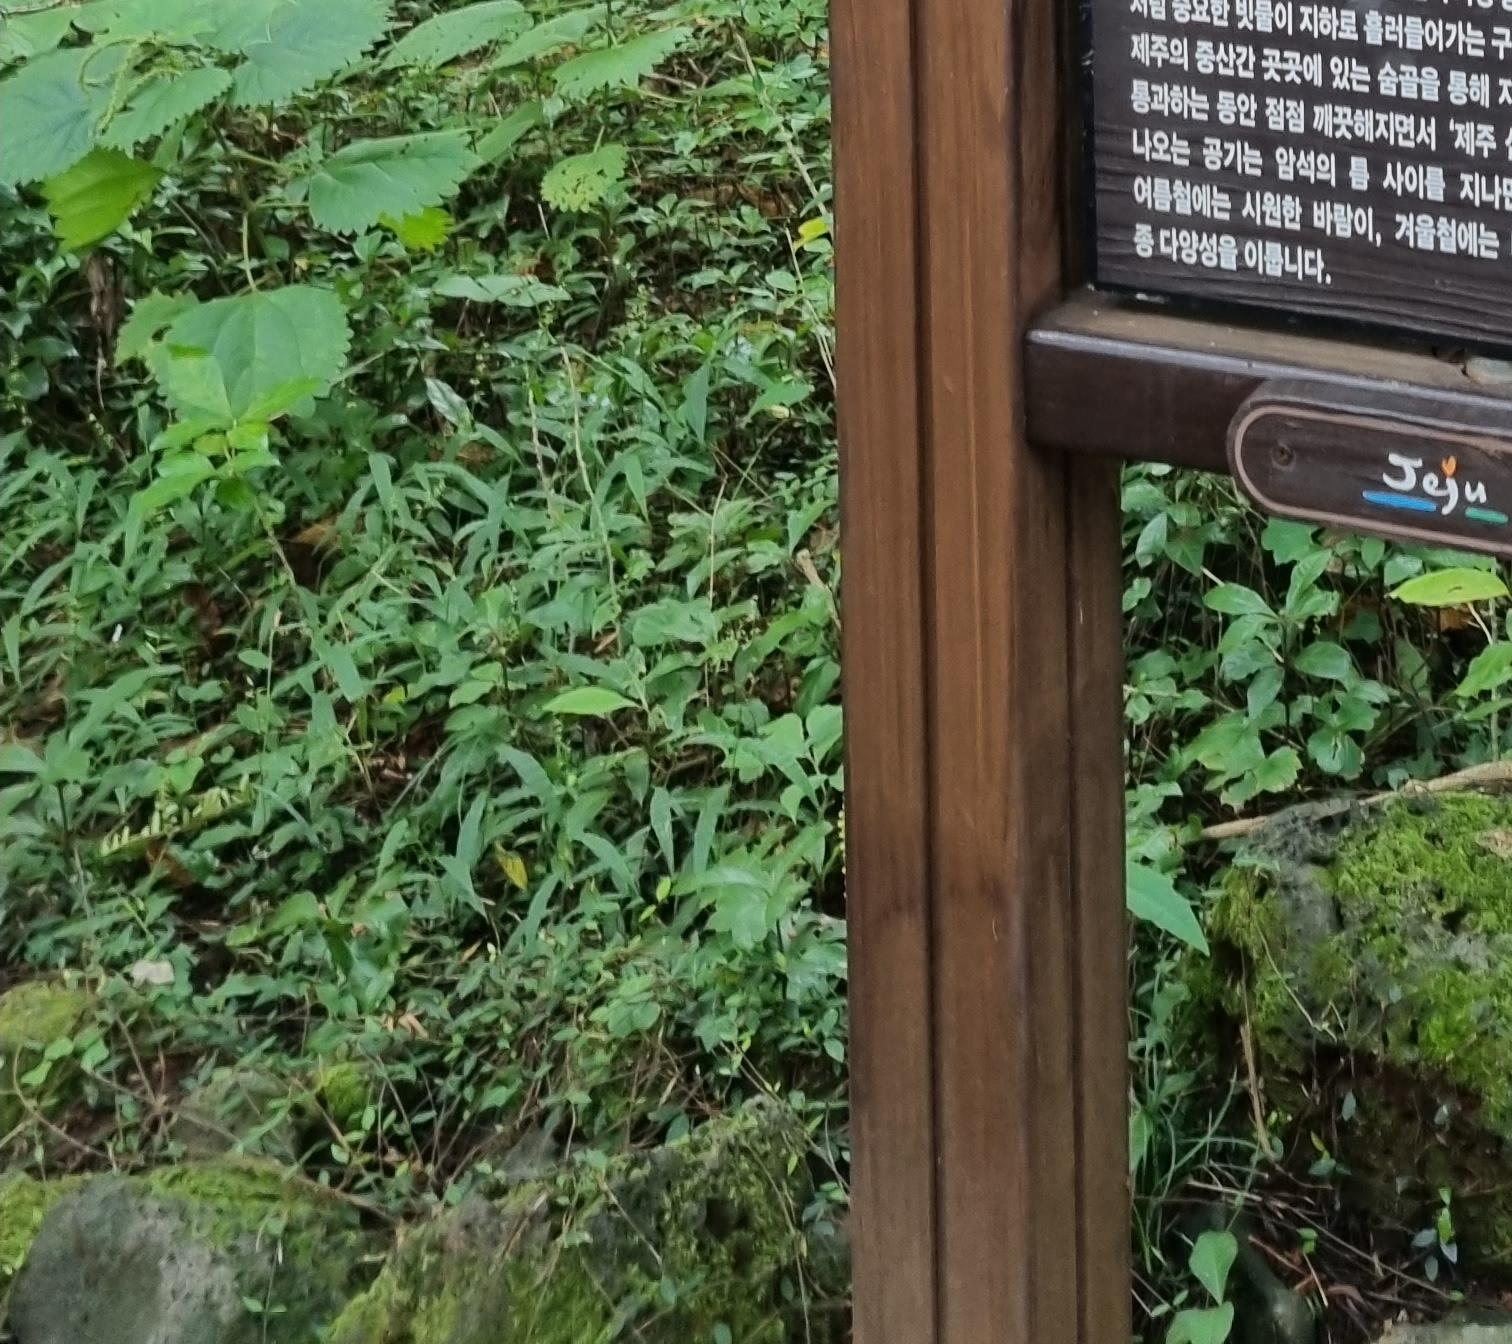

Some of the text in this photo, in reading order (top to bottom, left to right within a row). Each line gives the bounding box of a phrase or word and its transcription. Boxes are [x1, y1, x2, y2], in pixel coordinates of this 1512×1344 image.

[1299, 4, 1359, 41] 지하로
[1363, 9, 1486, 58] 흘러들어가는
[1130, 33, 1189, 72] 제주의
[1194, 40, 1256, 79] 중산간
[1261, 48, 1323, 88] 곳곳에
[1329, 56, 1371, 93] 있는
[1377, 61, 1441, 102] 숨골을
[1447, 70, 1490, 109] 통해
[1130, 79, 1210, 121] 통과하는
[1216, 90, 1258, 128] 동안
[1264, 97, 1305, 134] 점점
[1312, 103, 1436, 151] 깨끗해지면서
[1132, 127, 1191, 167] 나오는
[1202, 137, 1263, 177] 공기는
[1275, 146, 1336, 188] 암석의
[1348, 156, 1370, 191] 틈
[1382, 161, 1446, 202] 사이를
[1133, 175, 1232, 221] 여름철에는
[1241, 190, 1303, 231] 시원한
[1313, 200, 1382, 247] 바람이,
[1395, 212, 1500, 259] 겨울철에는
[1133, 223, 1332, 285] 종 다양성을 이룹니다.
[1381, 451, 1488, 515] Jeju
